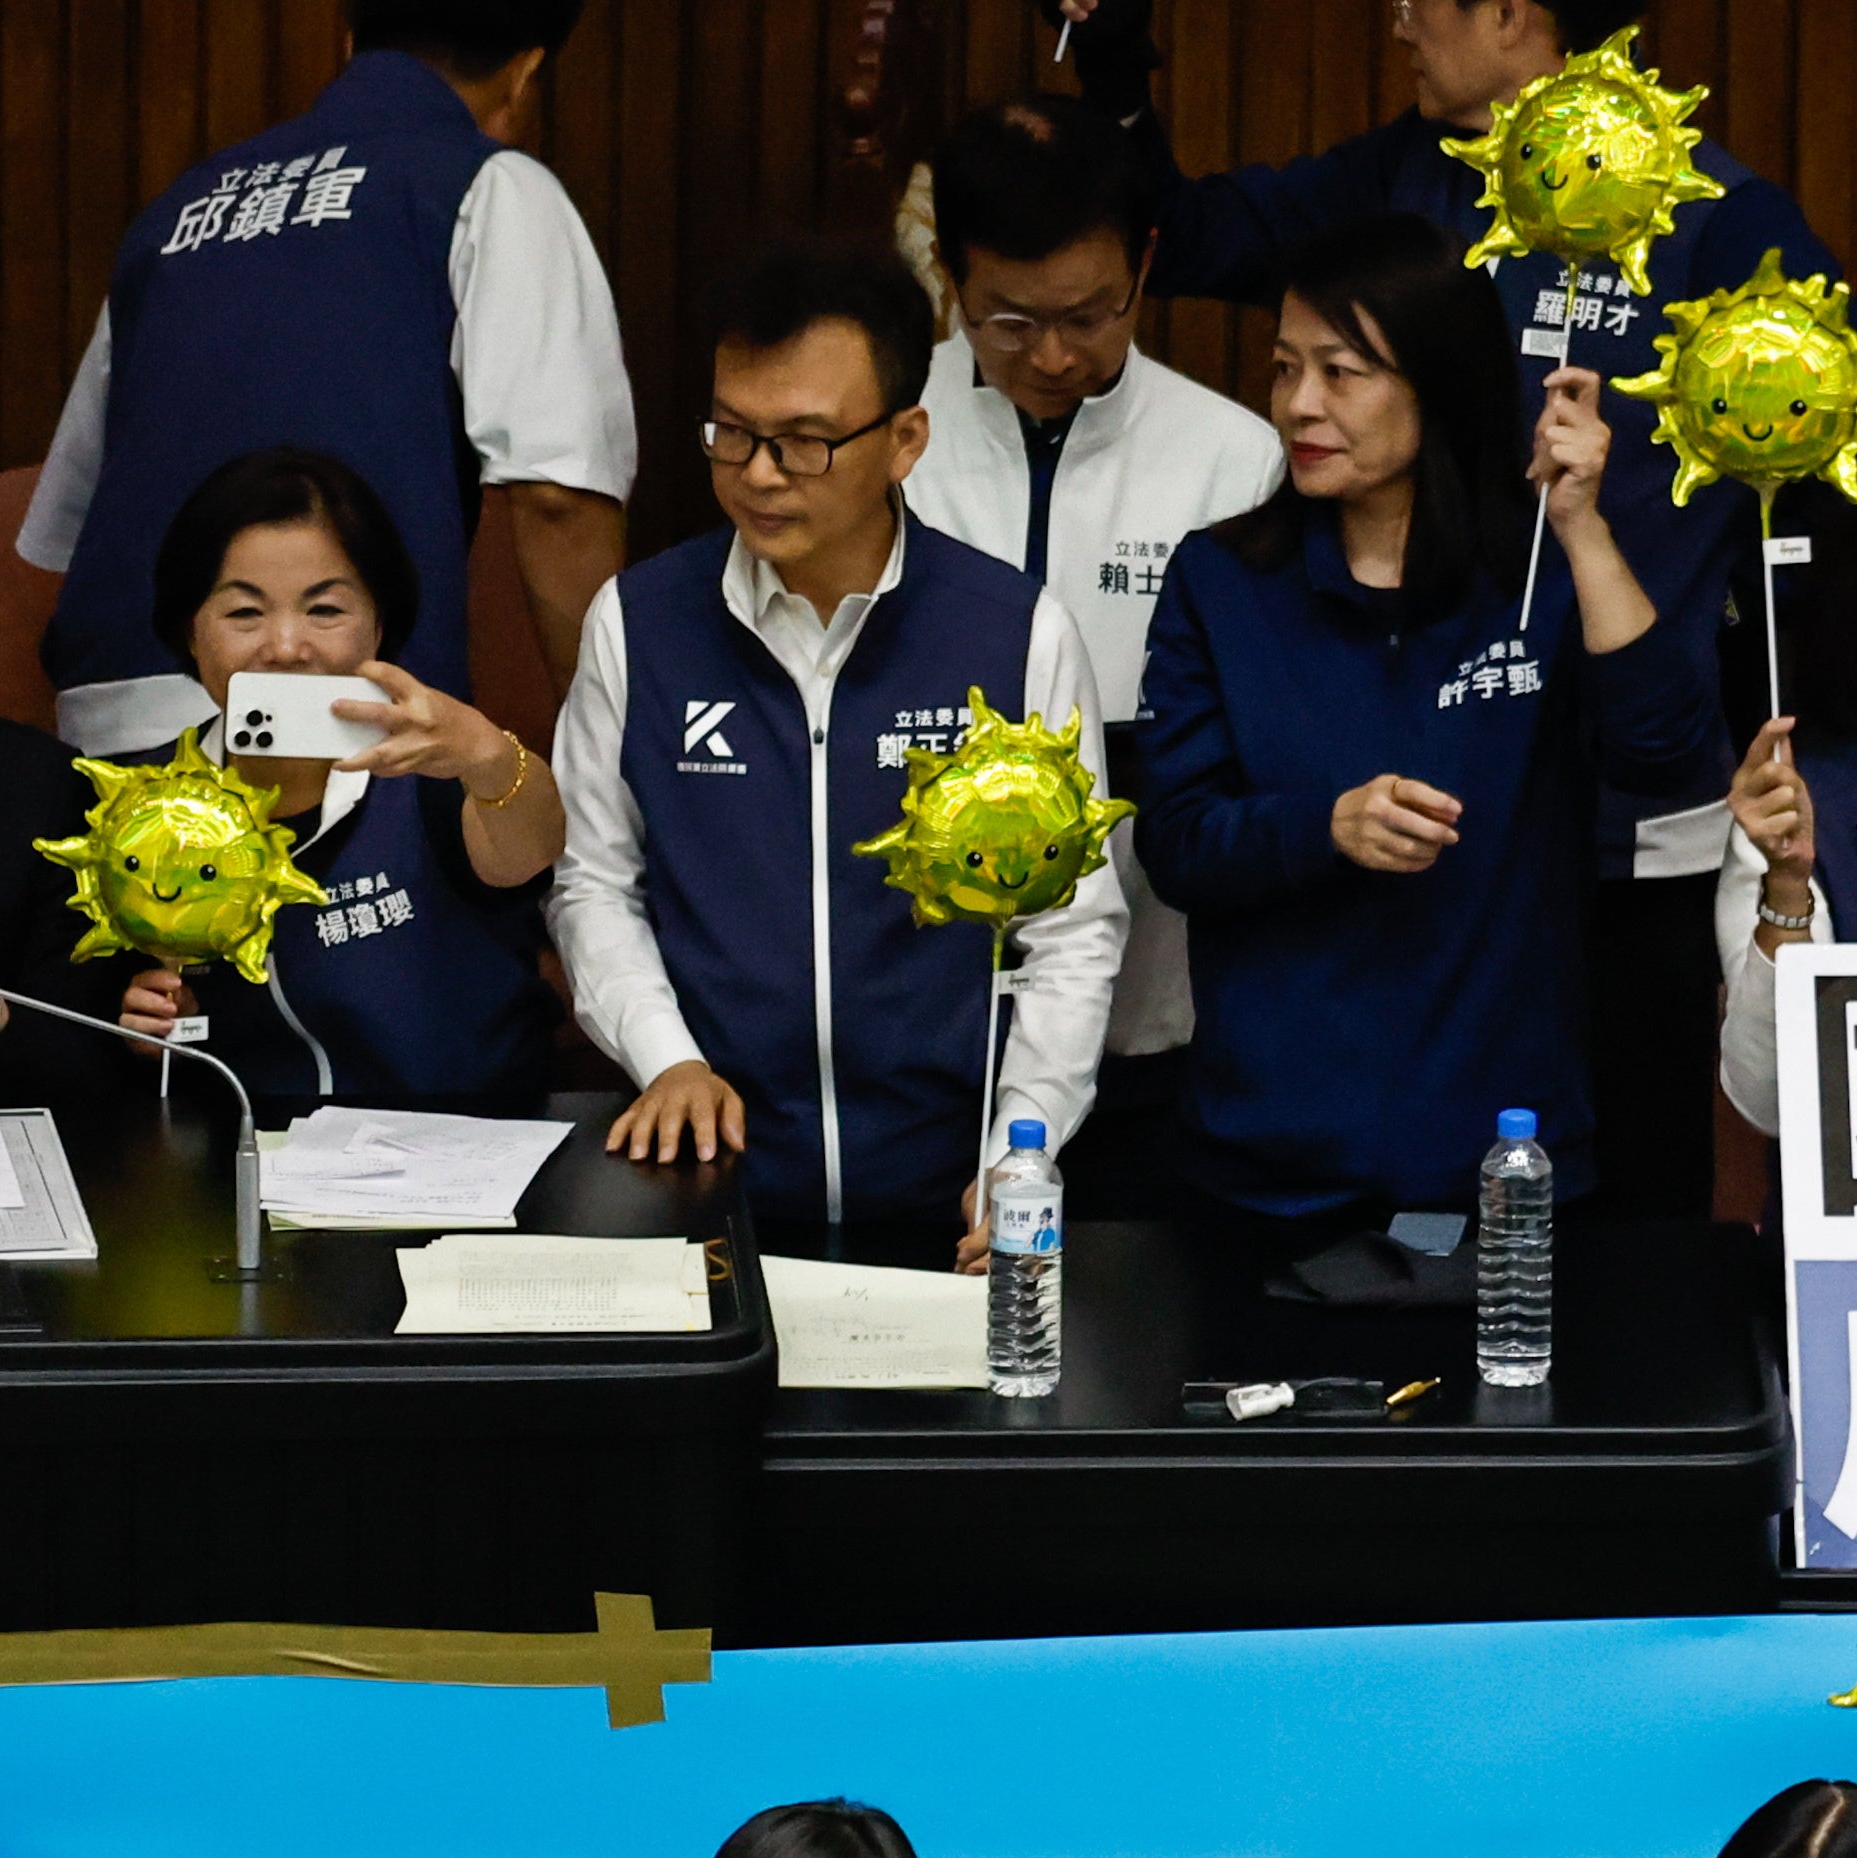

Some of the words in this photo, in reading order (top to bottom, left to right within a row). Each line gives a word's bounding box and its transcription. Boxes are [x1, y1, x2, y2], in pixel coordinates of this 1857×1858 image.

[212, 146, 348, 194] 立法委員
[160, 167, 367, 255] 邱鎮軍
[1533, 289, 1639, 336] 羅明才
[1115, 541, 1178, 558] 立法委
[1438, 660, 1542, 709] 許宇甄
[895, 707, 975, 729] 立法委員
[877, 733, 968, 769] 鄭正
[326, 871, 390, 904] 立法委員
[315, 888, 415, 947] 楊瓊瓔
